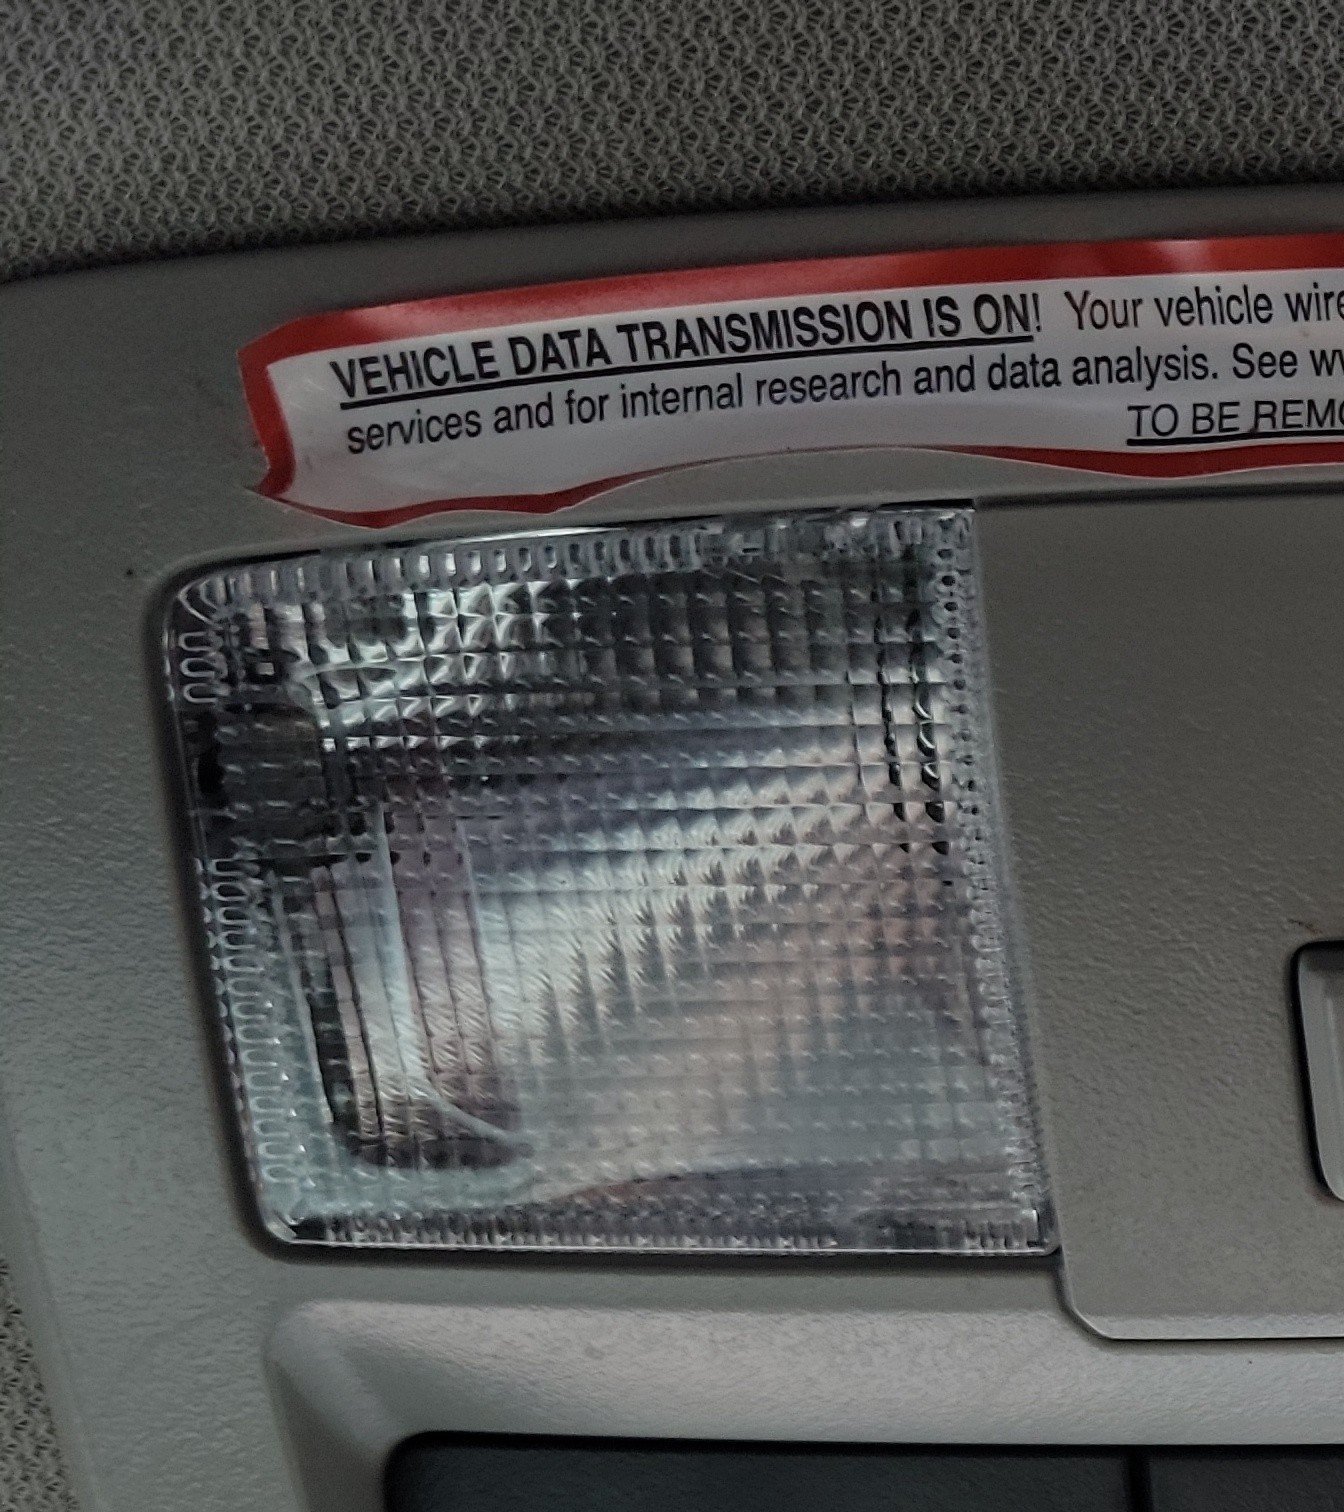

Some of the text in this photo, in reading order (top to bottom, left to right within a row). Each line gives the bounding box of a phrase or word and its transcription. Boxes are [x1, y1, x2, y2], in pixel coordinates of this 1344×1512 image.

[331, 345, 499, 400] VEHICLE
[510, 328, 611, 376] DATA
[618, 299, 914, 364] TRANSMISSION
[923, 298, 963, 338] IS
[973, 292, 1042, 335] ON!
[1065, 289, 1143, 332] Your
[1154, 284, 1272, 326] vehicle
[347, 398, 482, 455] services
[494, 390, 553, 433] and
[564, 387, 608, 424] for
[620, 381, 744, 419] internal
[755, 363, 903, 406] research
[914, 355, 974, 395] and
[987, 352, 1062, 390] data
[1071, 340, 1219, 390] analysis.
[1232, 345, 1298, 379] See
[1128, 403, 1178, 439] TO
[1191, 400, 1240, 435] BE
